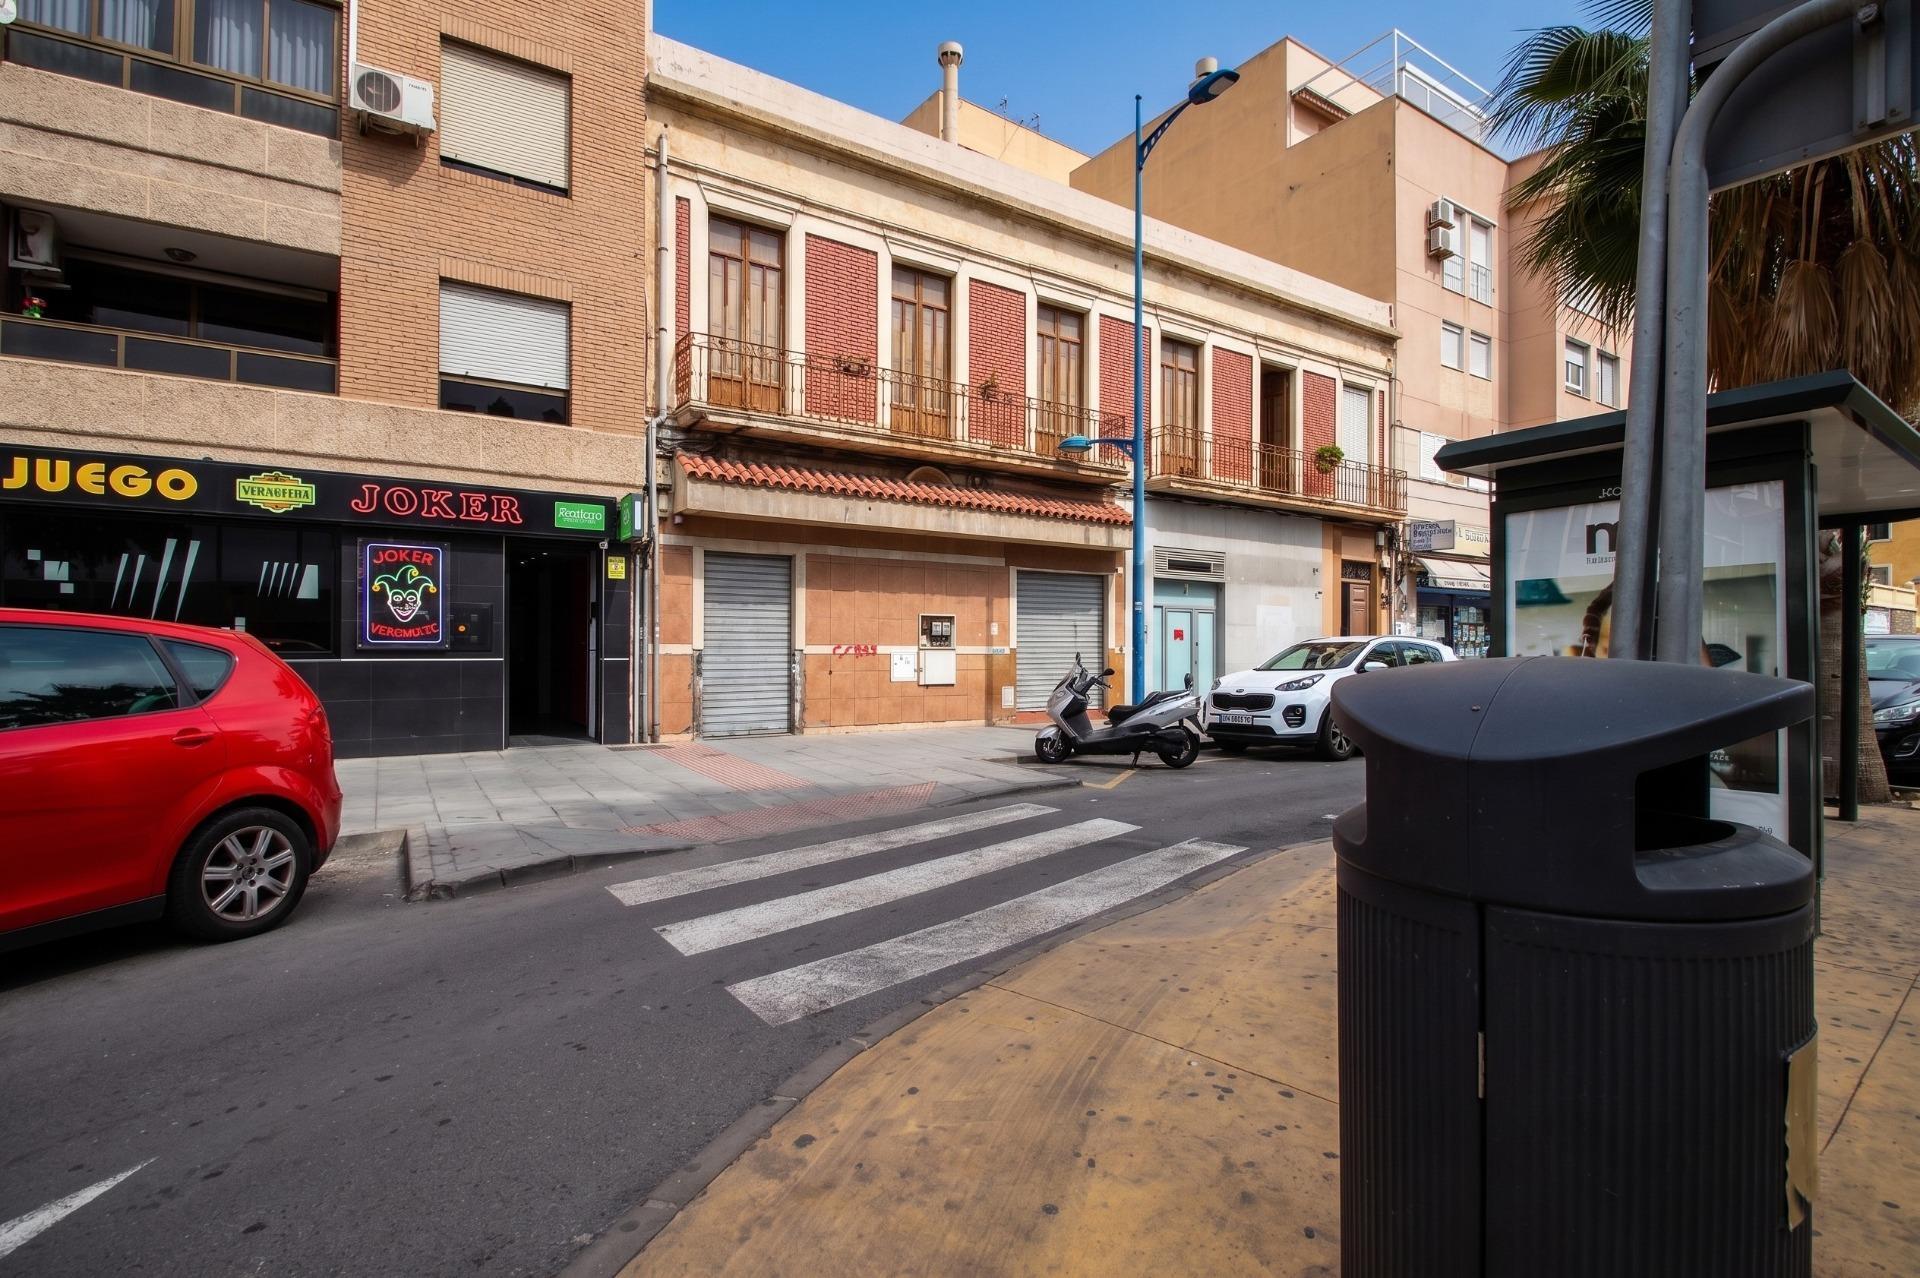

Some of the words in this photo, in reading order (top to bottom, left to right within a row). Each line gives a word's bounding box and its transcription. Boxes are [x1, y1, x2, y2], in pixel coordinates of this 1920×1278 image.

[3, 456, 198, 500] JUEGO
[351, 484, 523, 524] JOKER
[373, 549, 434, 566] JOKER
